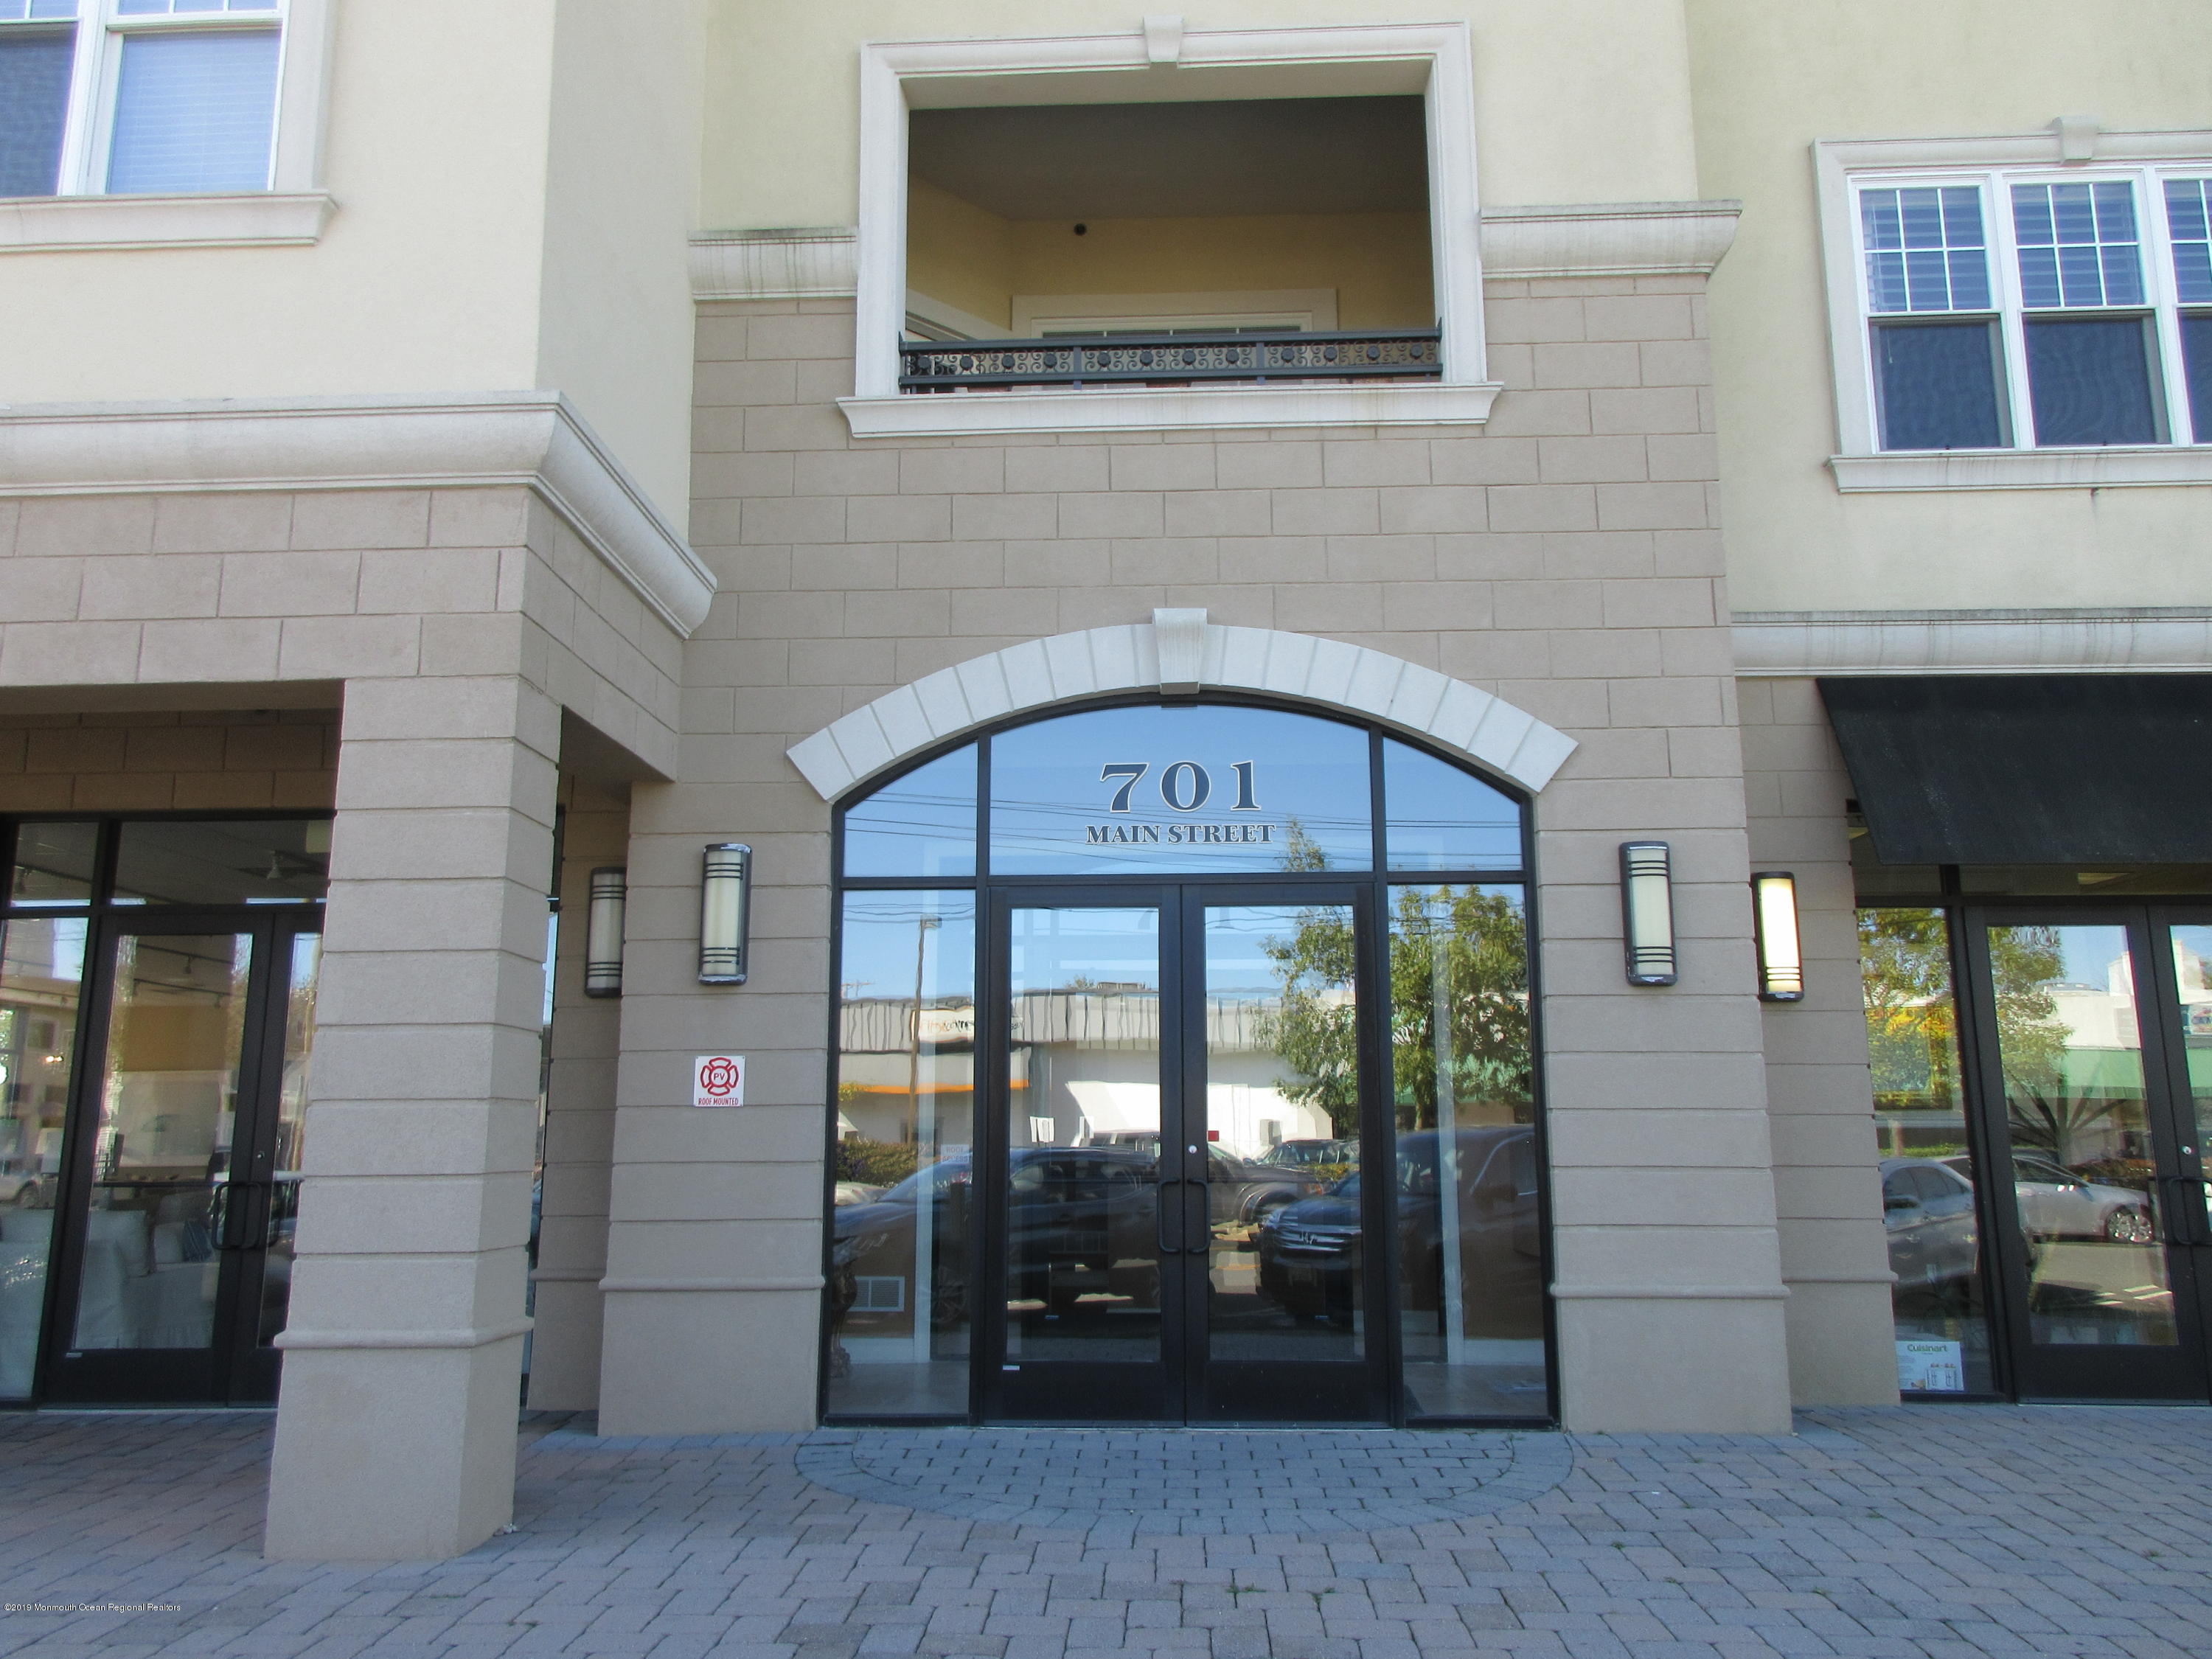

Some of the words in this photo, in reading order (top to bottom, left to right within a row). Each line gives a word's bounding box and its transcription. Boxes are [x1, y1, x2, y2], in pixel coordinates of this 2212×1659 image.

[1099, 759, 1262, 813] 701
[1085, 824, 1161, 845] MAIN
[1167, 824, 1276, 845] STREET
[1907, 1344, 1947, 1352] Cuisinart
